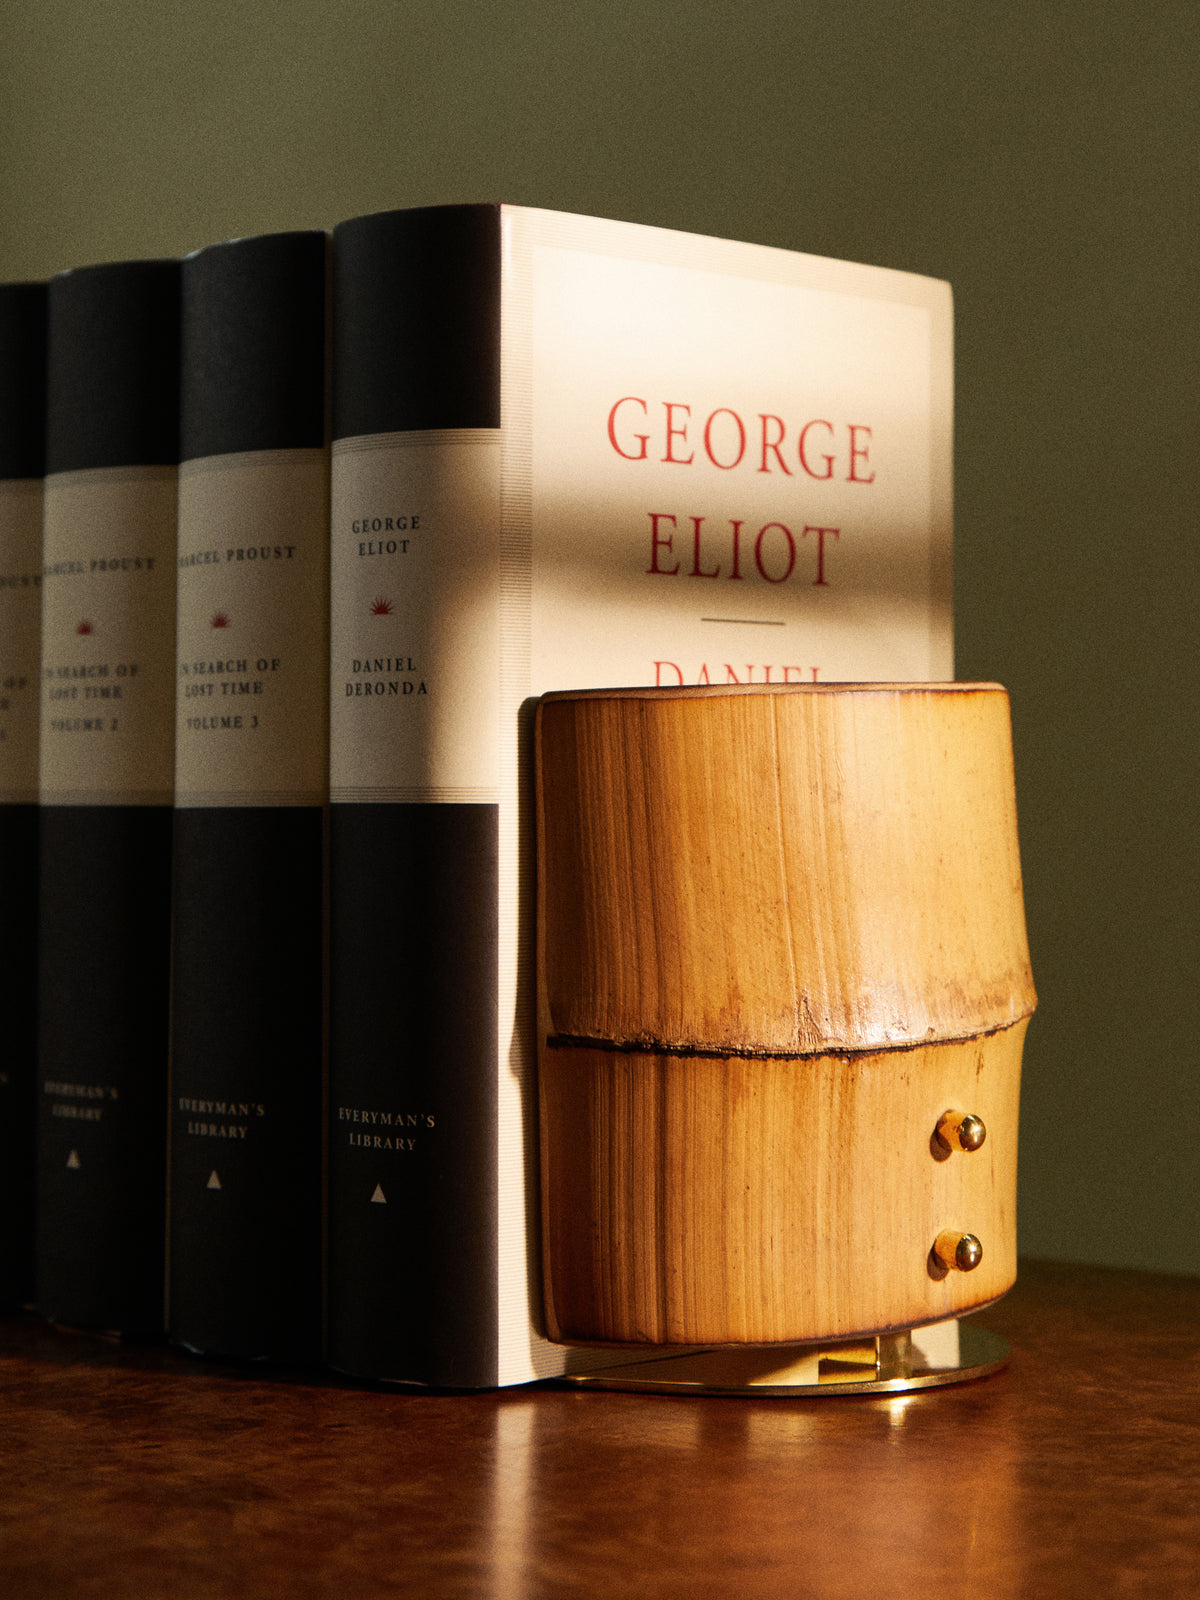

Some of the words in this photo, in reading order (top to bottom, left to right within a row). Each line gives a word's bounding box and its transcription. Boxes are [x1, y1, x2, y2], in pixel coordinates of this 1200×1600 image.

[607, 396, 876, 484] GEORGE
[352, 515, 421, 534] GEORGE
[226, 546, 297, 562] PROUST
[358, 540, 410, 556] ELIOT
[645, 512, 841, 587] ELIOT
[193, 659, 248, 676] SEARCH
[256, 658, 281, 673] OF
[352, 658, 417, 674] DANIEL
[185, 683, 214, 698] LOST
[221, 681, 264, 696] TIME
[345, 680, 428, 697] DERONDA
[187, 715, 244, 731] VOLUME
[250, 714, 260, 730] 3
[179, 1097, 265, 1117] EVERYMAN'S
[338, 1106, 436, 1128] EVERYMAN'S
[188, 1121, 248, 1139] LIBRARY
[349, 1132, 417, 1151] LIBRARY
